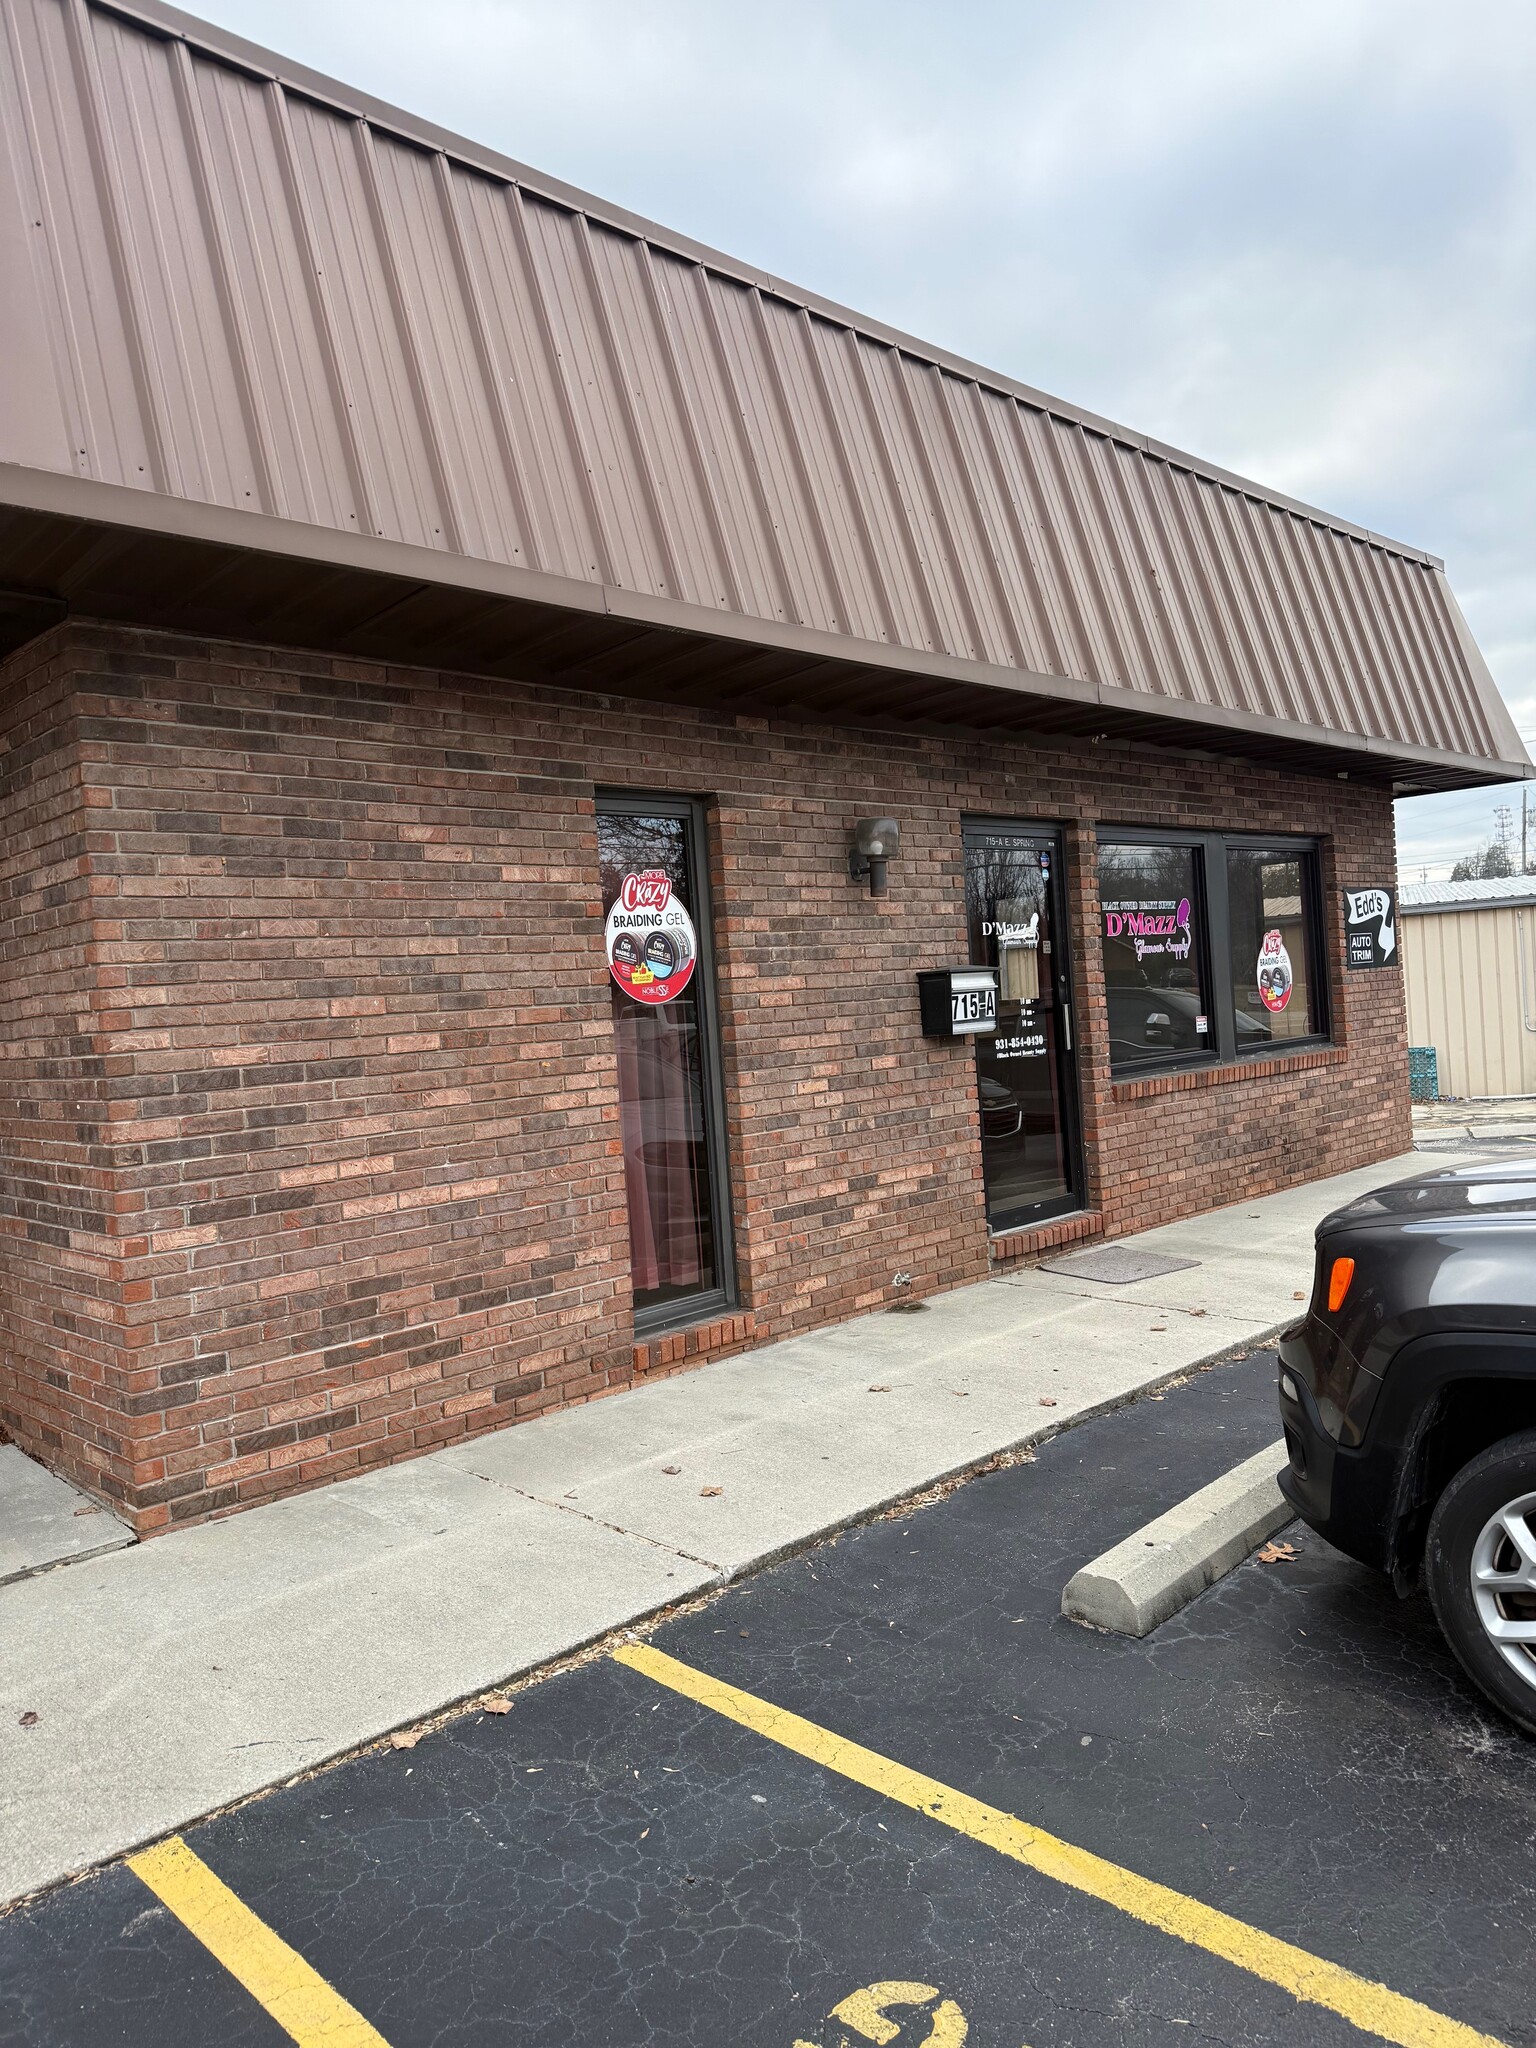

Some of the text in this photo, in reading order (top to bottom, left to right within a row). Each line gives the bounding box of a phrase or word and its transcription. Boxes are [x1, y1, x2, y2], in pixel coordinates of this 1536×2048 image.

[1013, 838, 1034, 847] SPRING
[1355, 892, 1383, 918] Edd's
[613, 912, 685, 928] BRAIDING GEL
[1106, 912, 1177, 937] D'Mazz
[982, 921, 1028, 936] D'Mazz
[1351, 936, 1371, 948] AUTO
[1352, 950, 1372, 961] TRIM
[952, 991, 994, 1020] 715-A
[995, 1035, 1044, 1049] 931-854-0430
